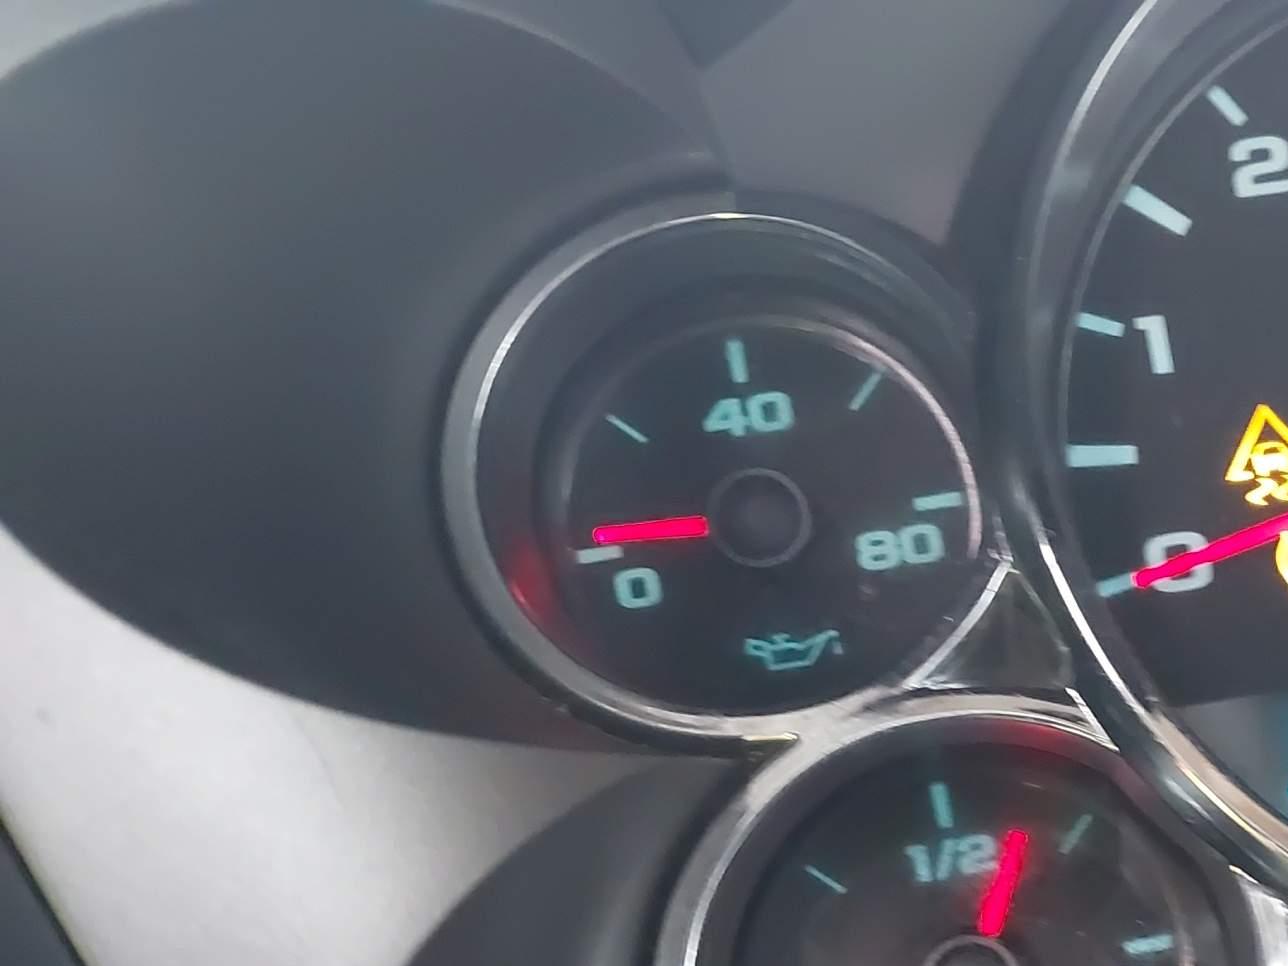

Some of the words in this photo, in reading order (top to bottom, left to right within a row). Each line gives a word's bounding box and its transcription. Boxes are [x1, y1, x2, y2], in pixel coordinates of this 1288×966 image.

[1134, 315, 1174, 374] 1
[703, 391, 795, 436] 40
[855, 524, 944, 570] 80
[1144, 531, 1213, 592] 0
[613, 567, 663, 608] 0
[905, 834, 1000, 883] 1/2
